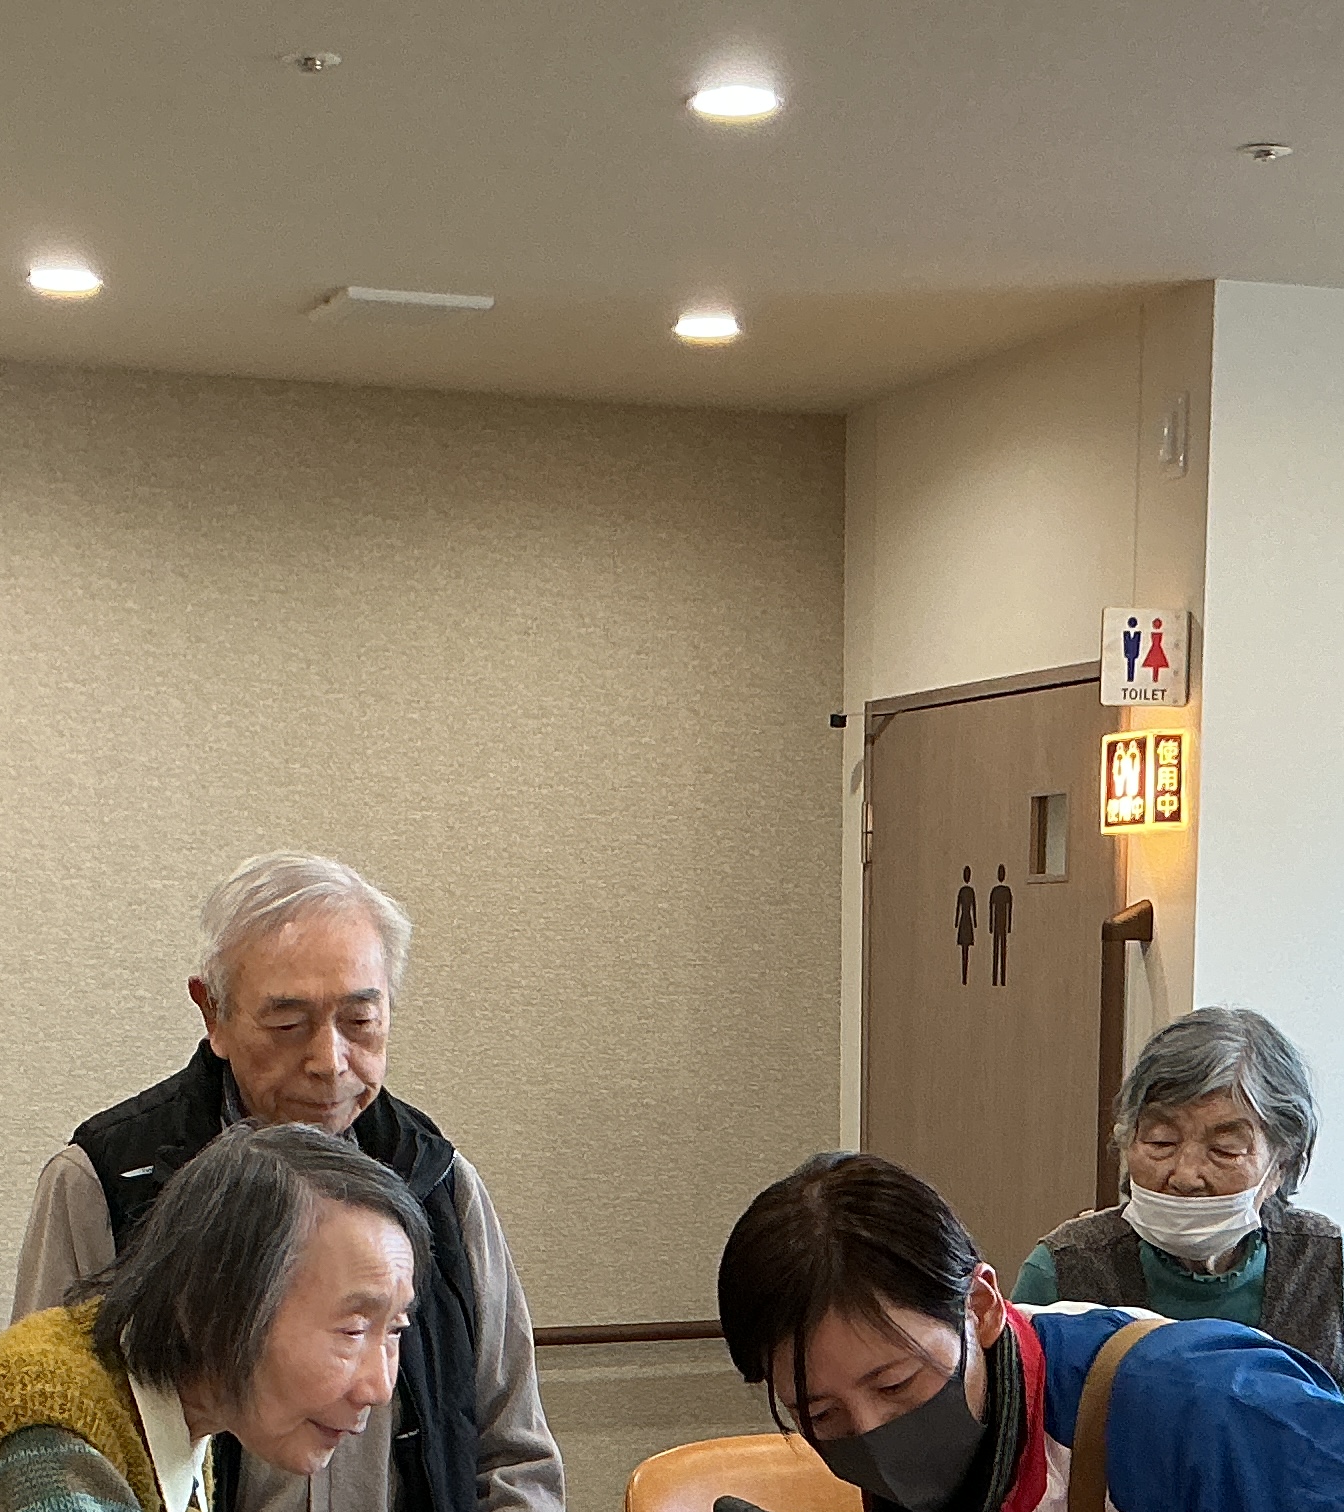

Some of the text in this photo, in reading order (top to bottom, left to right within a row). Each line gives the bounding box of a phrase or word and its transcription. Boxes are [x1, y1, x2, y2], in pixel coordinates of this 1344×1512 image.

[1121, 687, 1167, 702] TOILET
[1156, 738, 1180, 818] 使用中
